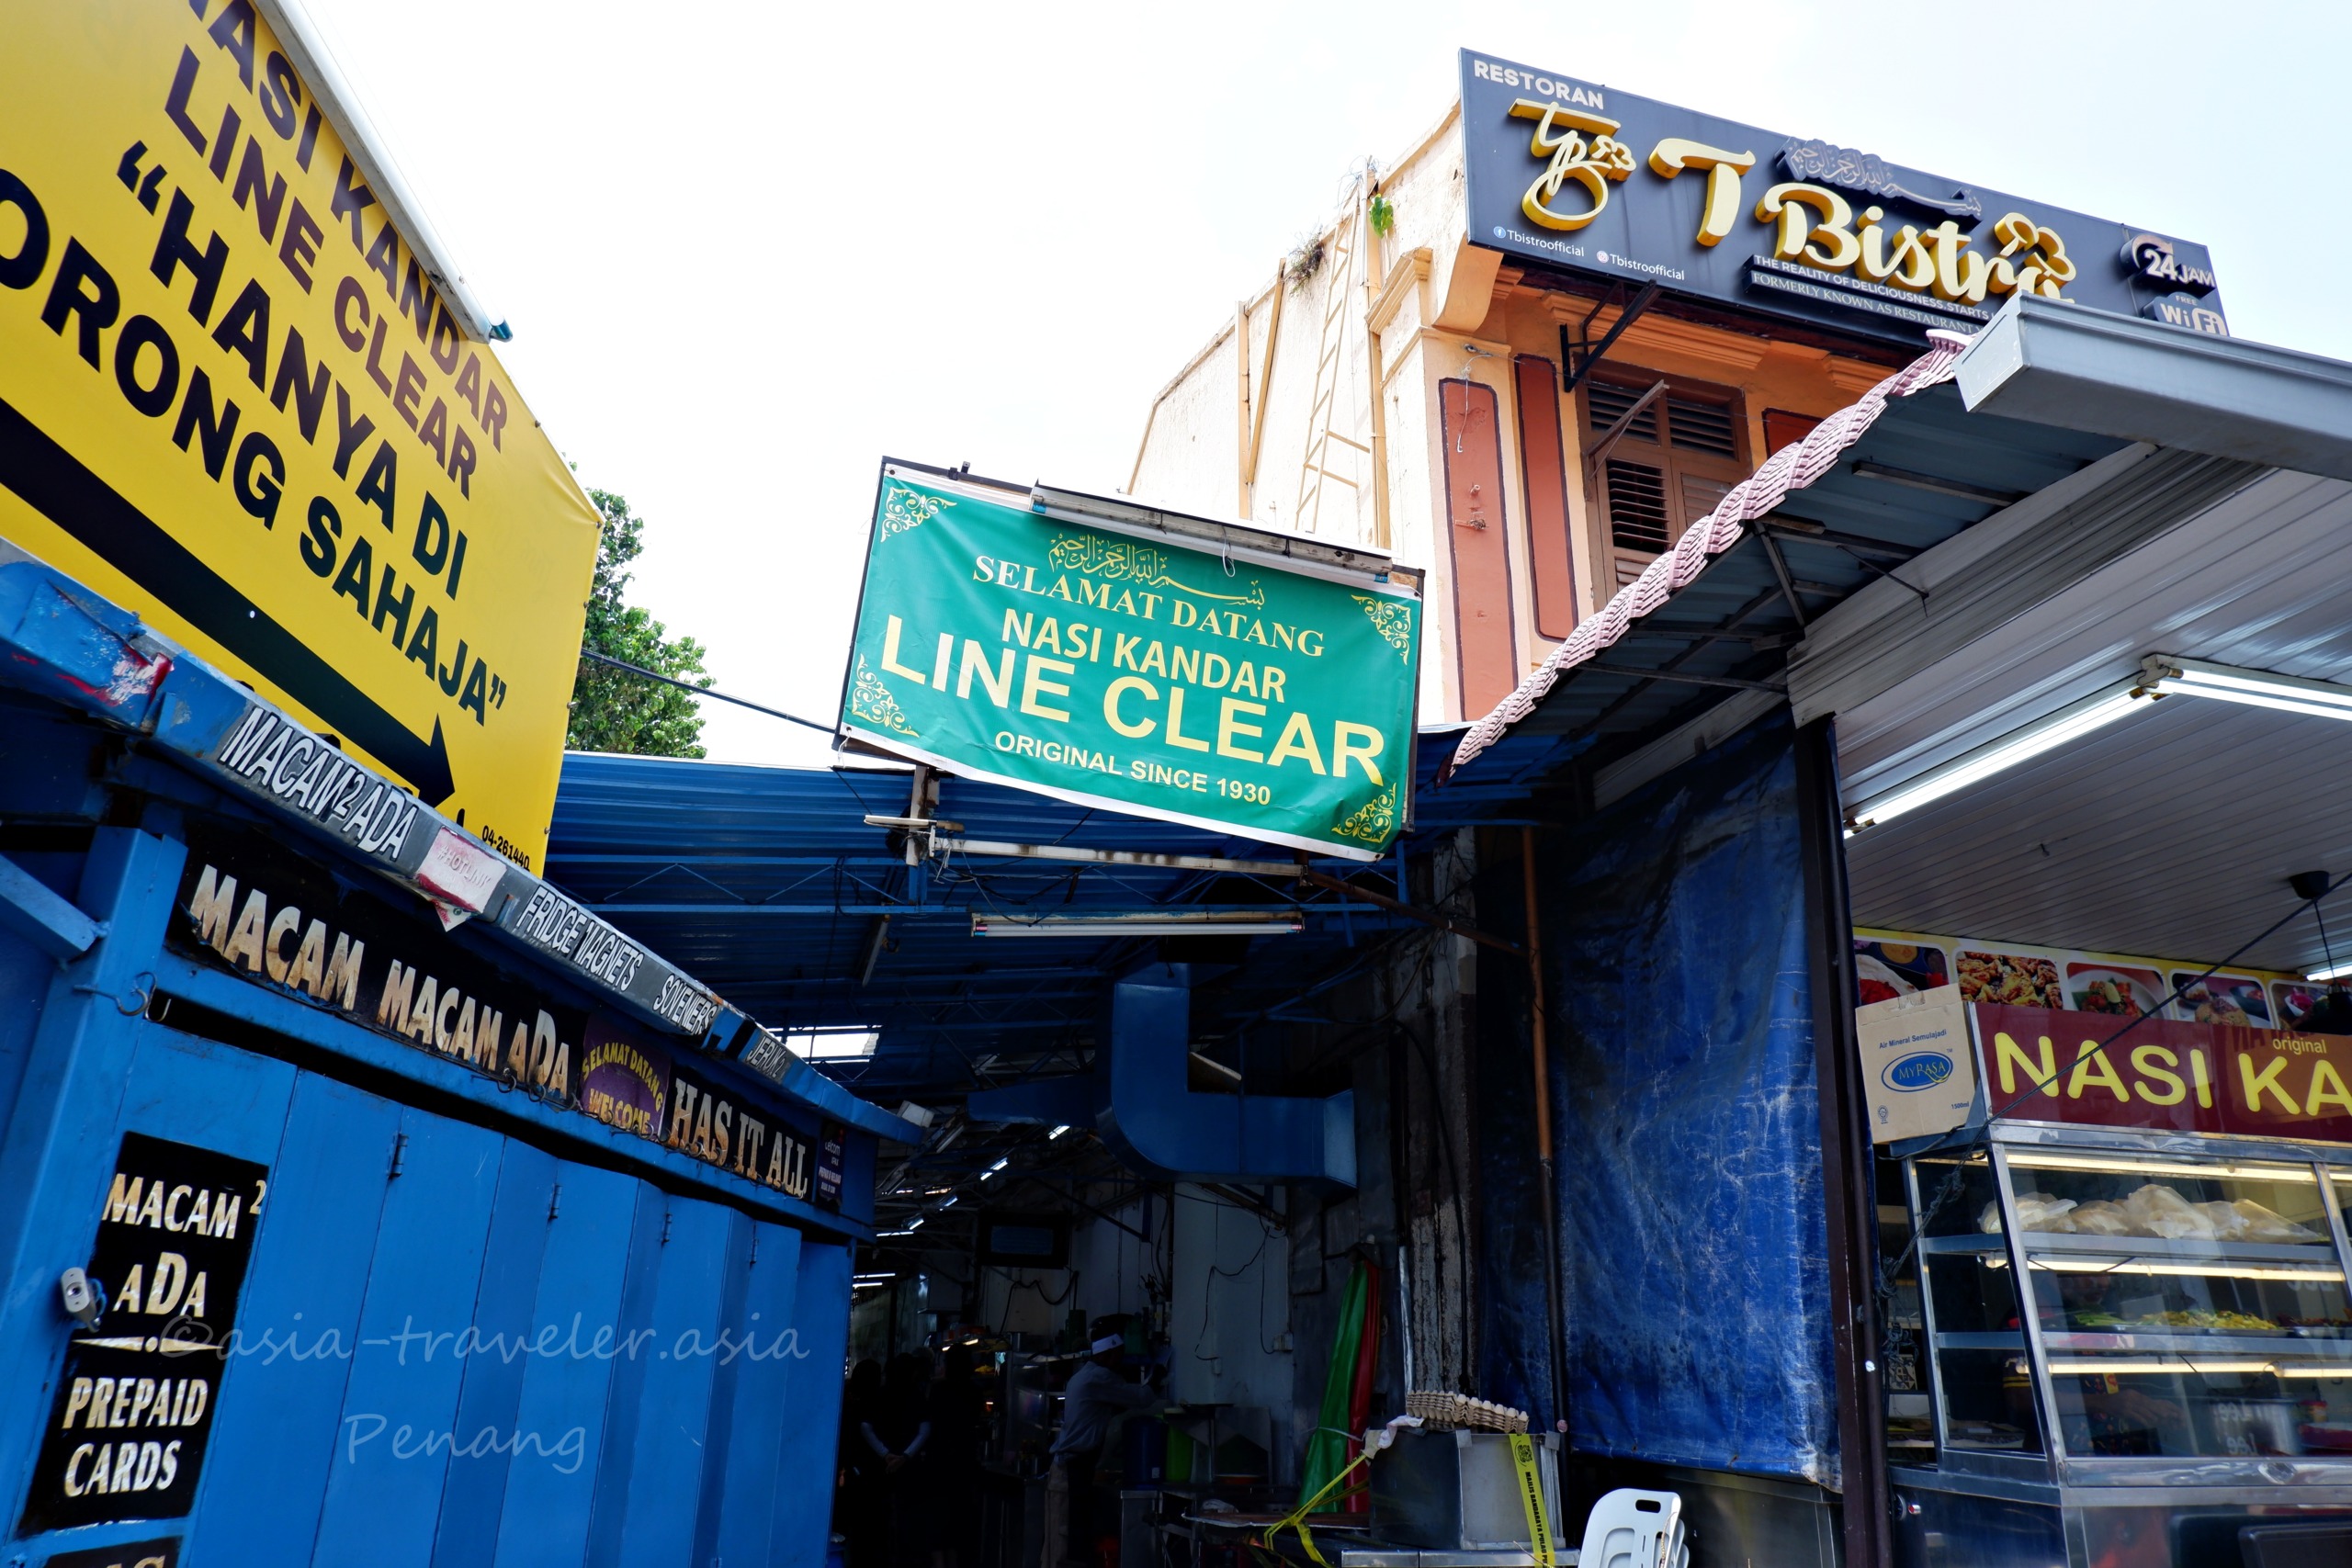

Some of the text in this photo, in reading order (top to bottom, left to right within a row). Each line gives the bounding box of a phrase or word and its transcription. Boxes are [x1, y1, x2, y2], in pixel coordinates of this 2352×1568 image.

[1475, 60, 1604, 110] RESTORAN
[188, 0, 507, 451] ASI KANDAR
[1648, 138, 1756, 247] T
[164, 43, 476, 501] LINE CLEAR
[1507, 230, 1585, 257] Tbistroofficial
[1610, 254, 1685, 281] Tbistroofficial
[1754, 255, 1779, 269] THE
[1782, 263, 1830, 281] REALITY
[1833, 275, 1849, 287] OF
[2144, 249, 2215, 287] 24 JAM
[1754, 273, 1973, 333] FORMERLY KNOWN AS RESTAURANT
[2176, 295, 2198, 306] FREE
[412, 491, 468, 600] DI
[972, 556, 1325, 657] SELAMAT DATANG
[1002, 609, 1286, 703] NASI KANDAR
[880, 615, 1385, 787] LINE CLEAR
[995, 731, 1271, 806] ORIGINAL SINCE 1930
[343, 781, 418, 861] ADA
[515, 886, 644, 992] FRIDGE MAGNETS
[190, 864, 569, 1099] MACAM MACAM ADA
[1889, 1036, 1910, 1047] Mineral
[1912, 1029, 1947, 1043] Semulajadi
[1994, 1032, 2212, 1109] NASI
[2272, 1036, 2327, 1055] original
[582, 1042, 664, 1111] SELAMAT DATANG
[589, 1089, 651, 1134] WELCOME
[669, 1077, 808, 1196] HAS IT ALL
[113, 1252, 207, 1318] ADA
[62, 1377, 209, 1429] PREPAID
[63, 1439, 181, 1497] CARDS
[1530, 1494, 1543, 1532] BANDARAYA
[1538, 1533, 1547, 1553] PULAU
